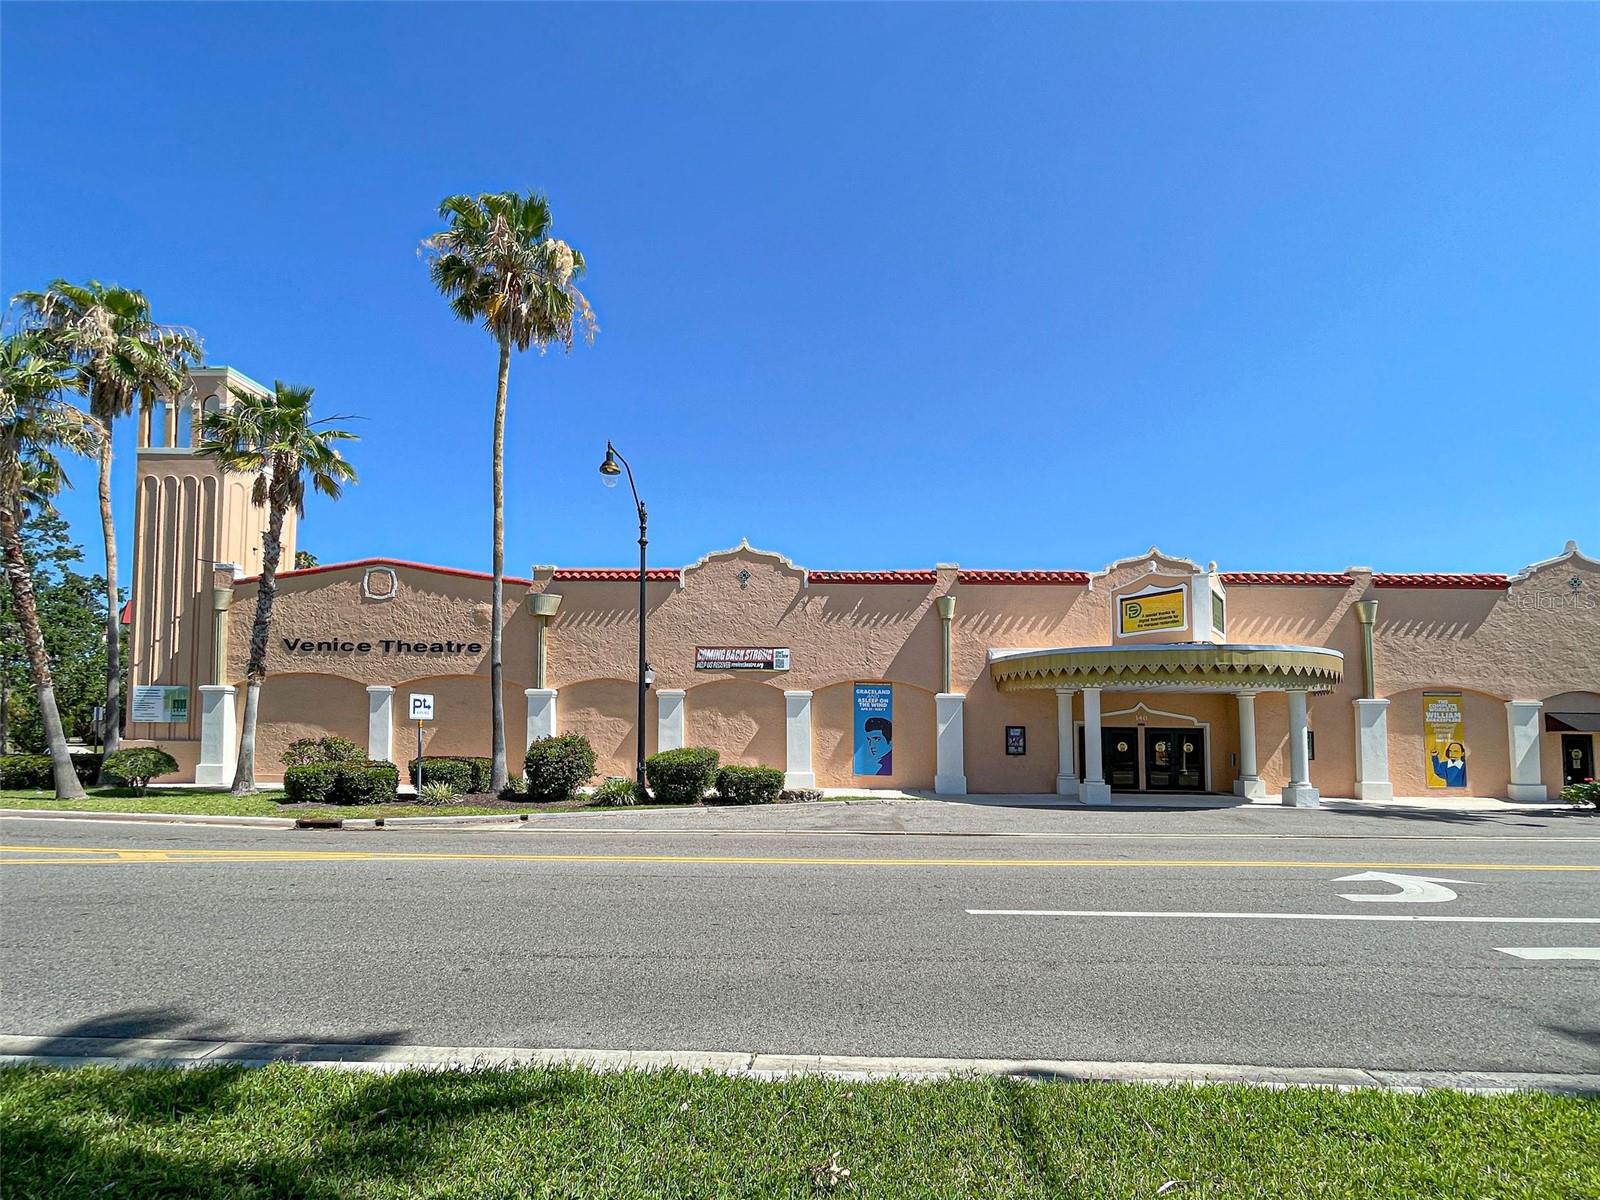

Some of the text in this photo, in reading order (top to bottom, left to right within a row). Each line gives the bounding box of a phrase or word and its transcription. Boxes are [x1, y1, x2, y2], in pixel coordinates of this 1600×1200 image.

[283, 638, 482, 653] Venice Theatre
[697, 648, 726, 661] COMING
[726, 649, 744, 661] BACK
[744, 649, 773, 661] STRONG
[413, 698, 423, 714] P
[1426, 711, 1461, 719] WILLIAM
